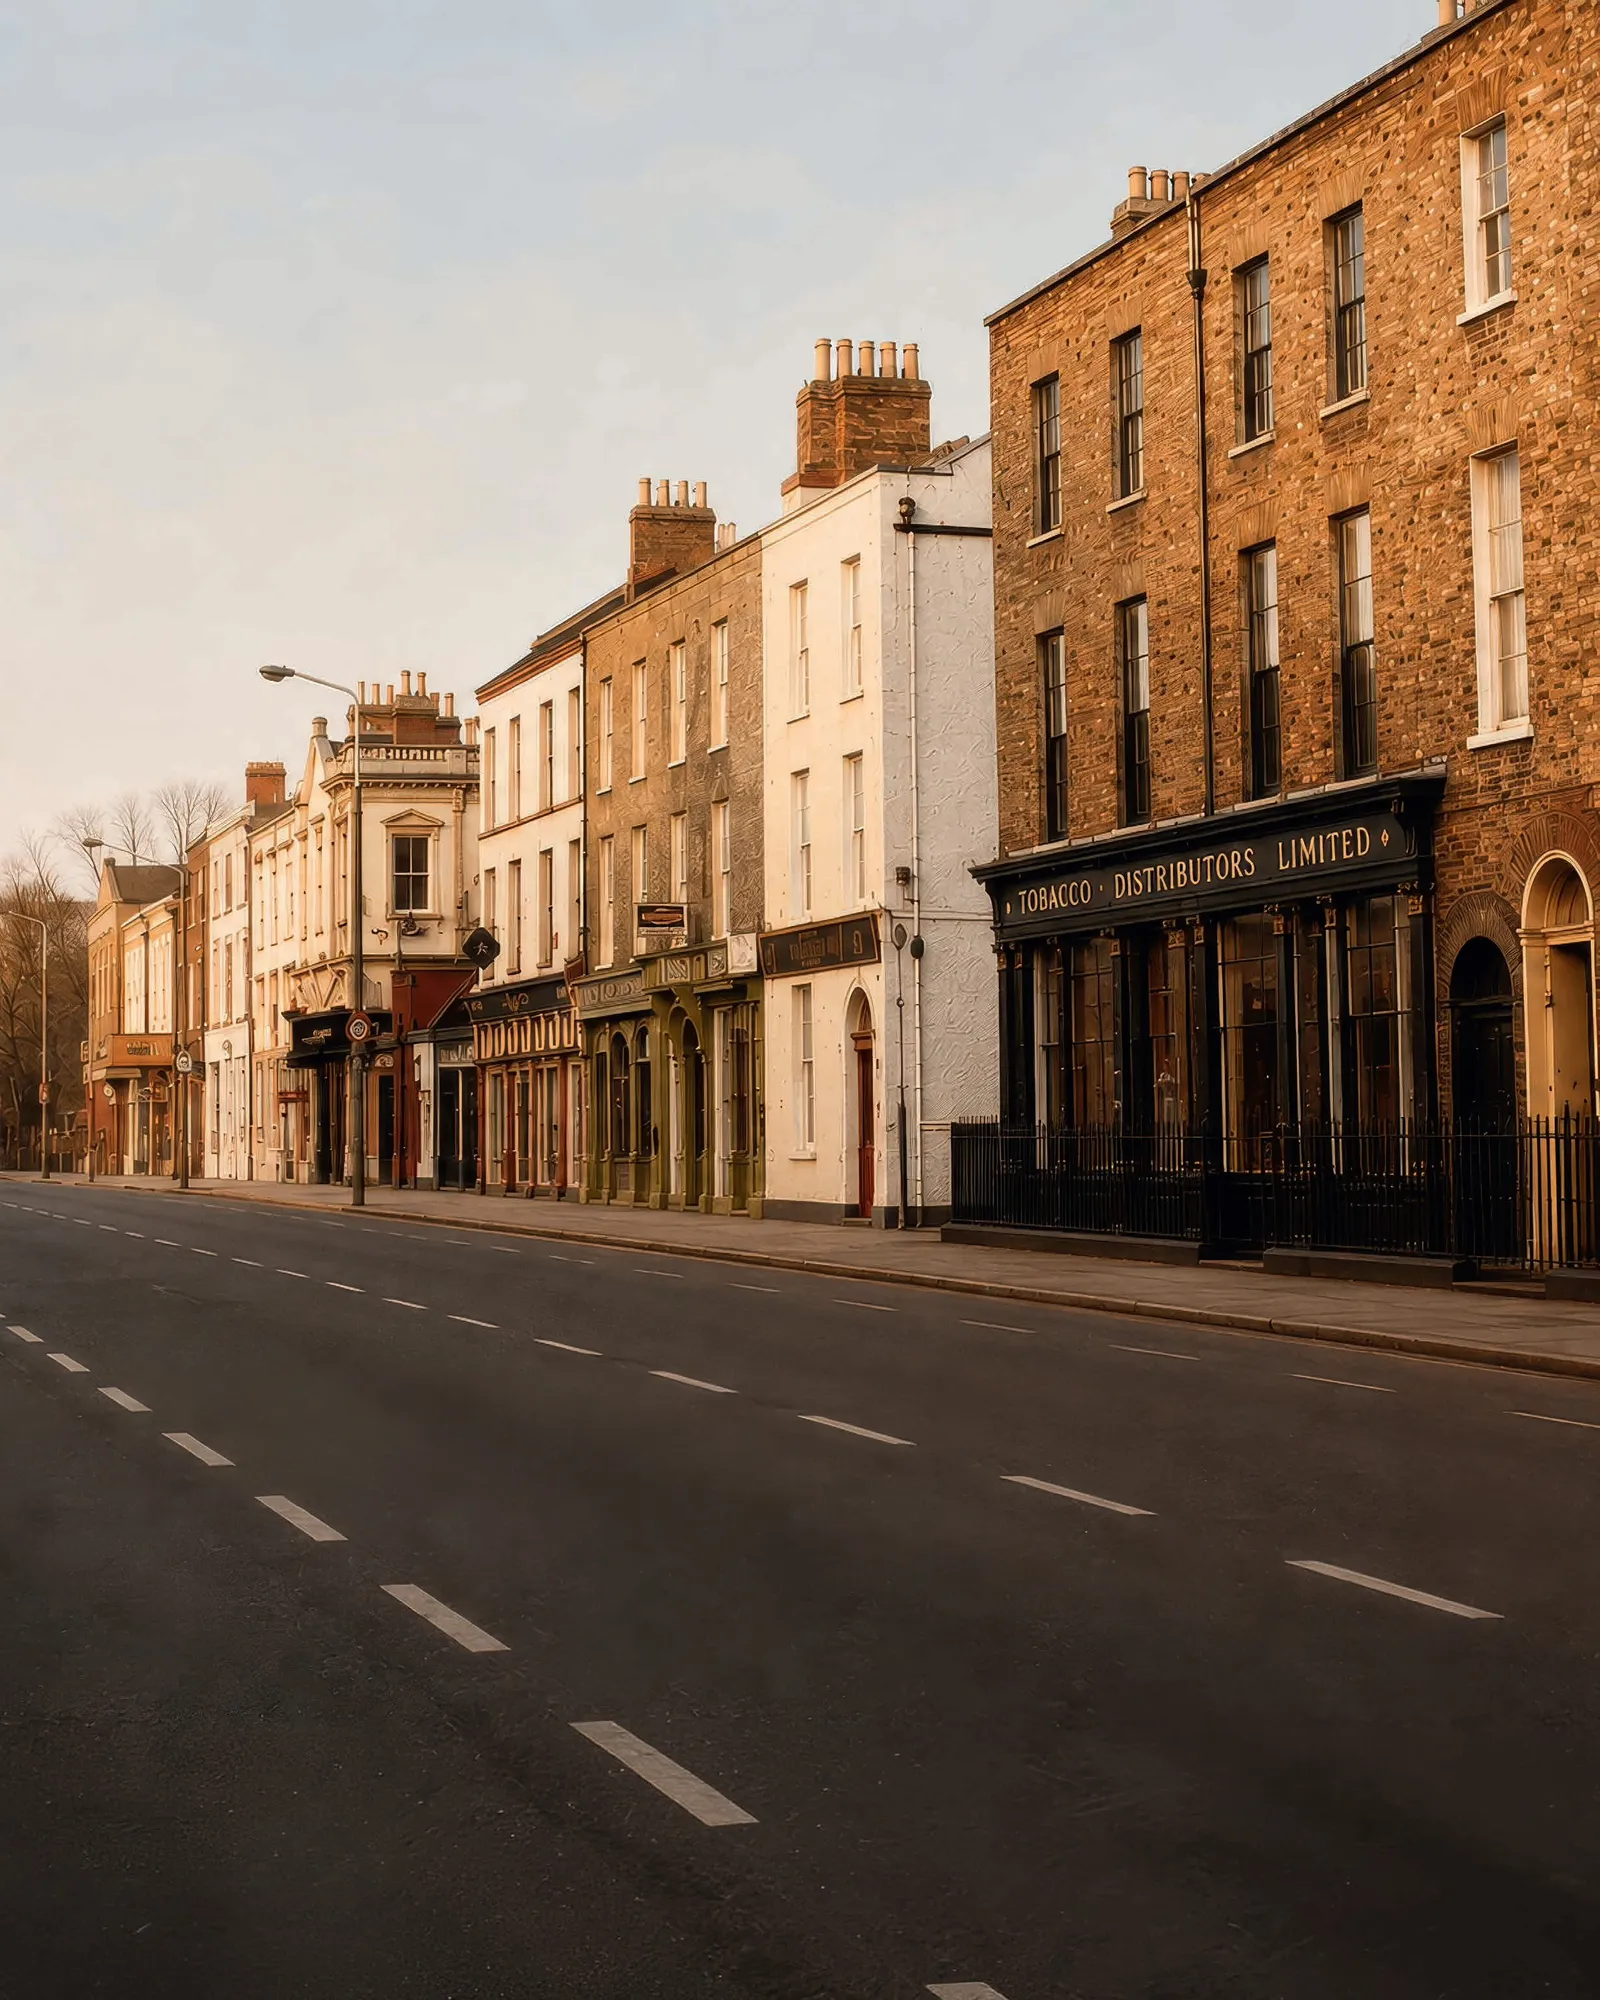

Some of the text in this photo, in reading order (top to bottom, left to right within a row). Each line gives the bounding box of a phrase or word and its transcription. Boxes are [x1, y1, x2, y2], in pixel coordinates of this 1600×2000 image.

[1018, 826, 1371, 915] TOBACCO DISTRIBUTORS LIMITED
